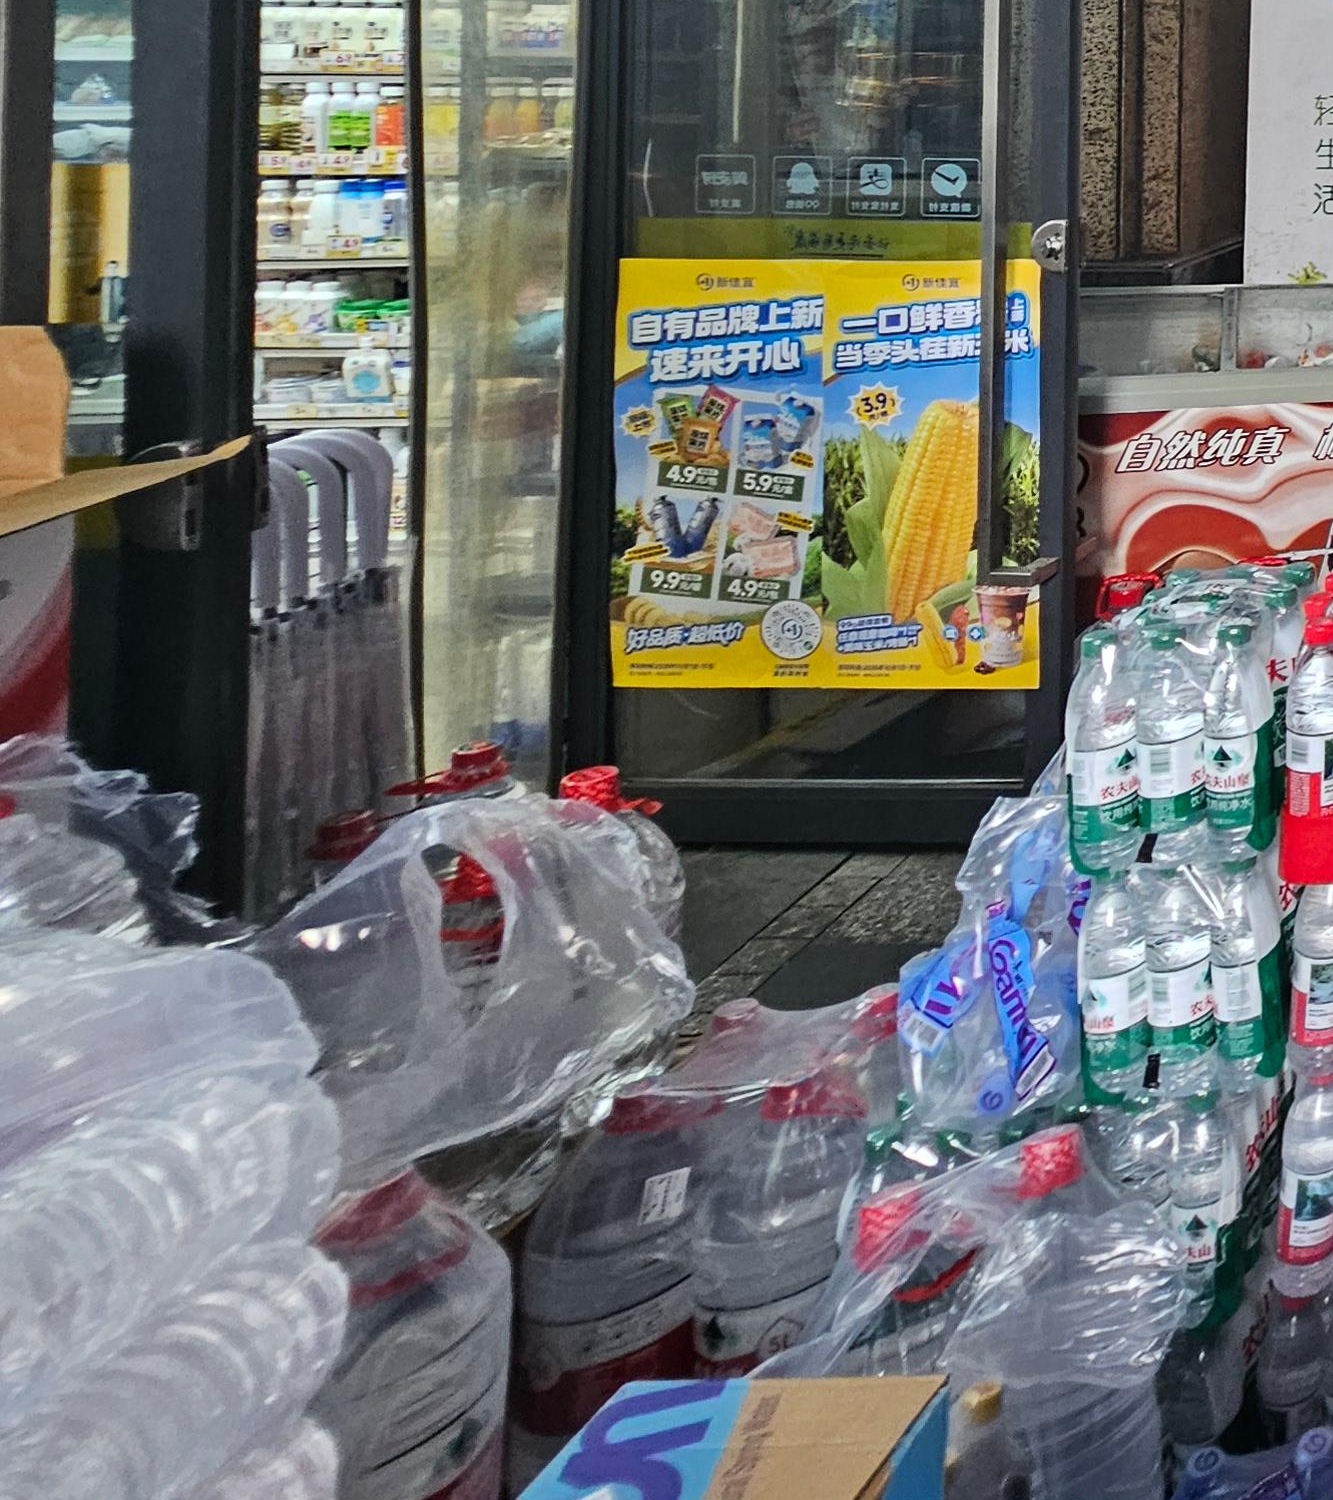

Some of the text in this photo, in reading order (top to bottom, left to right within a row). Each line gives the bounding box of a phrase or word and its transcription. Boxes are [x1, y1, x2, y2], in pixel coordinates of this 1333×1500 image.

[631, 298, 824, 344] 自有品牌上新
[843, 299, 981, 335] 一口鲜香
[649, 336, 800, 383] 速来开心
[860, 392, 888, 414] 3.9
[1115, 427, 1290, 474] 自然纯真
[666, 464, 697, 484] 4.9
[743, 473, 773, 492] 5.9
[650, 569, 681, 591] 9.9
[727, 578, 758, 598] 4.9
